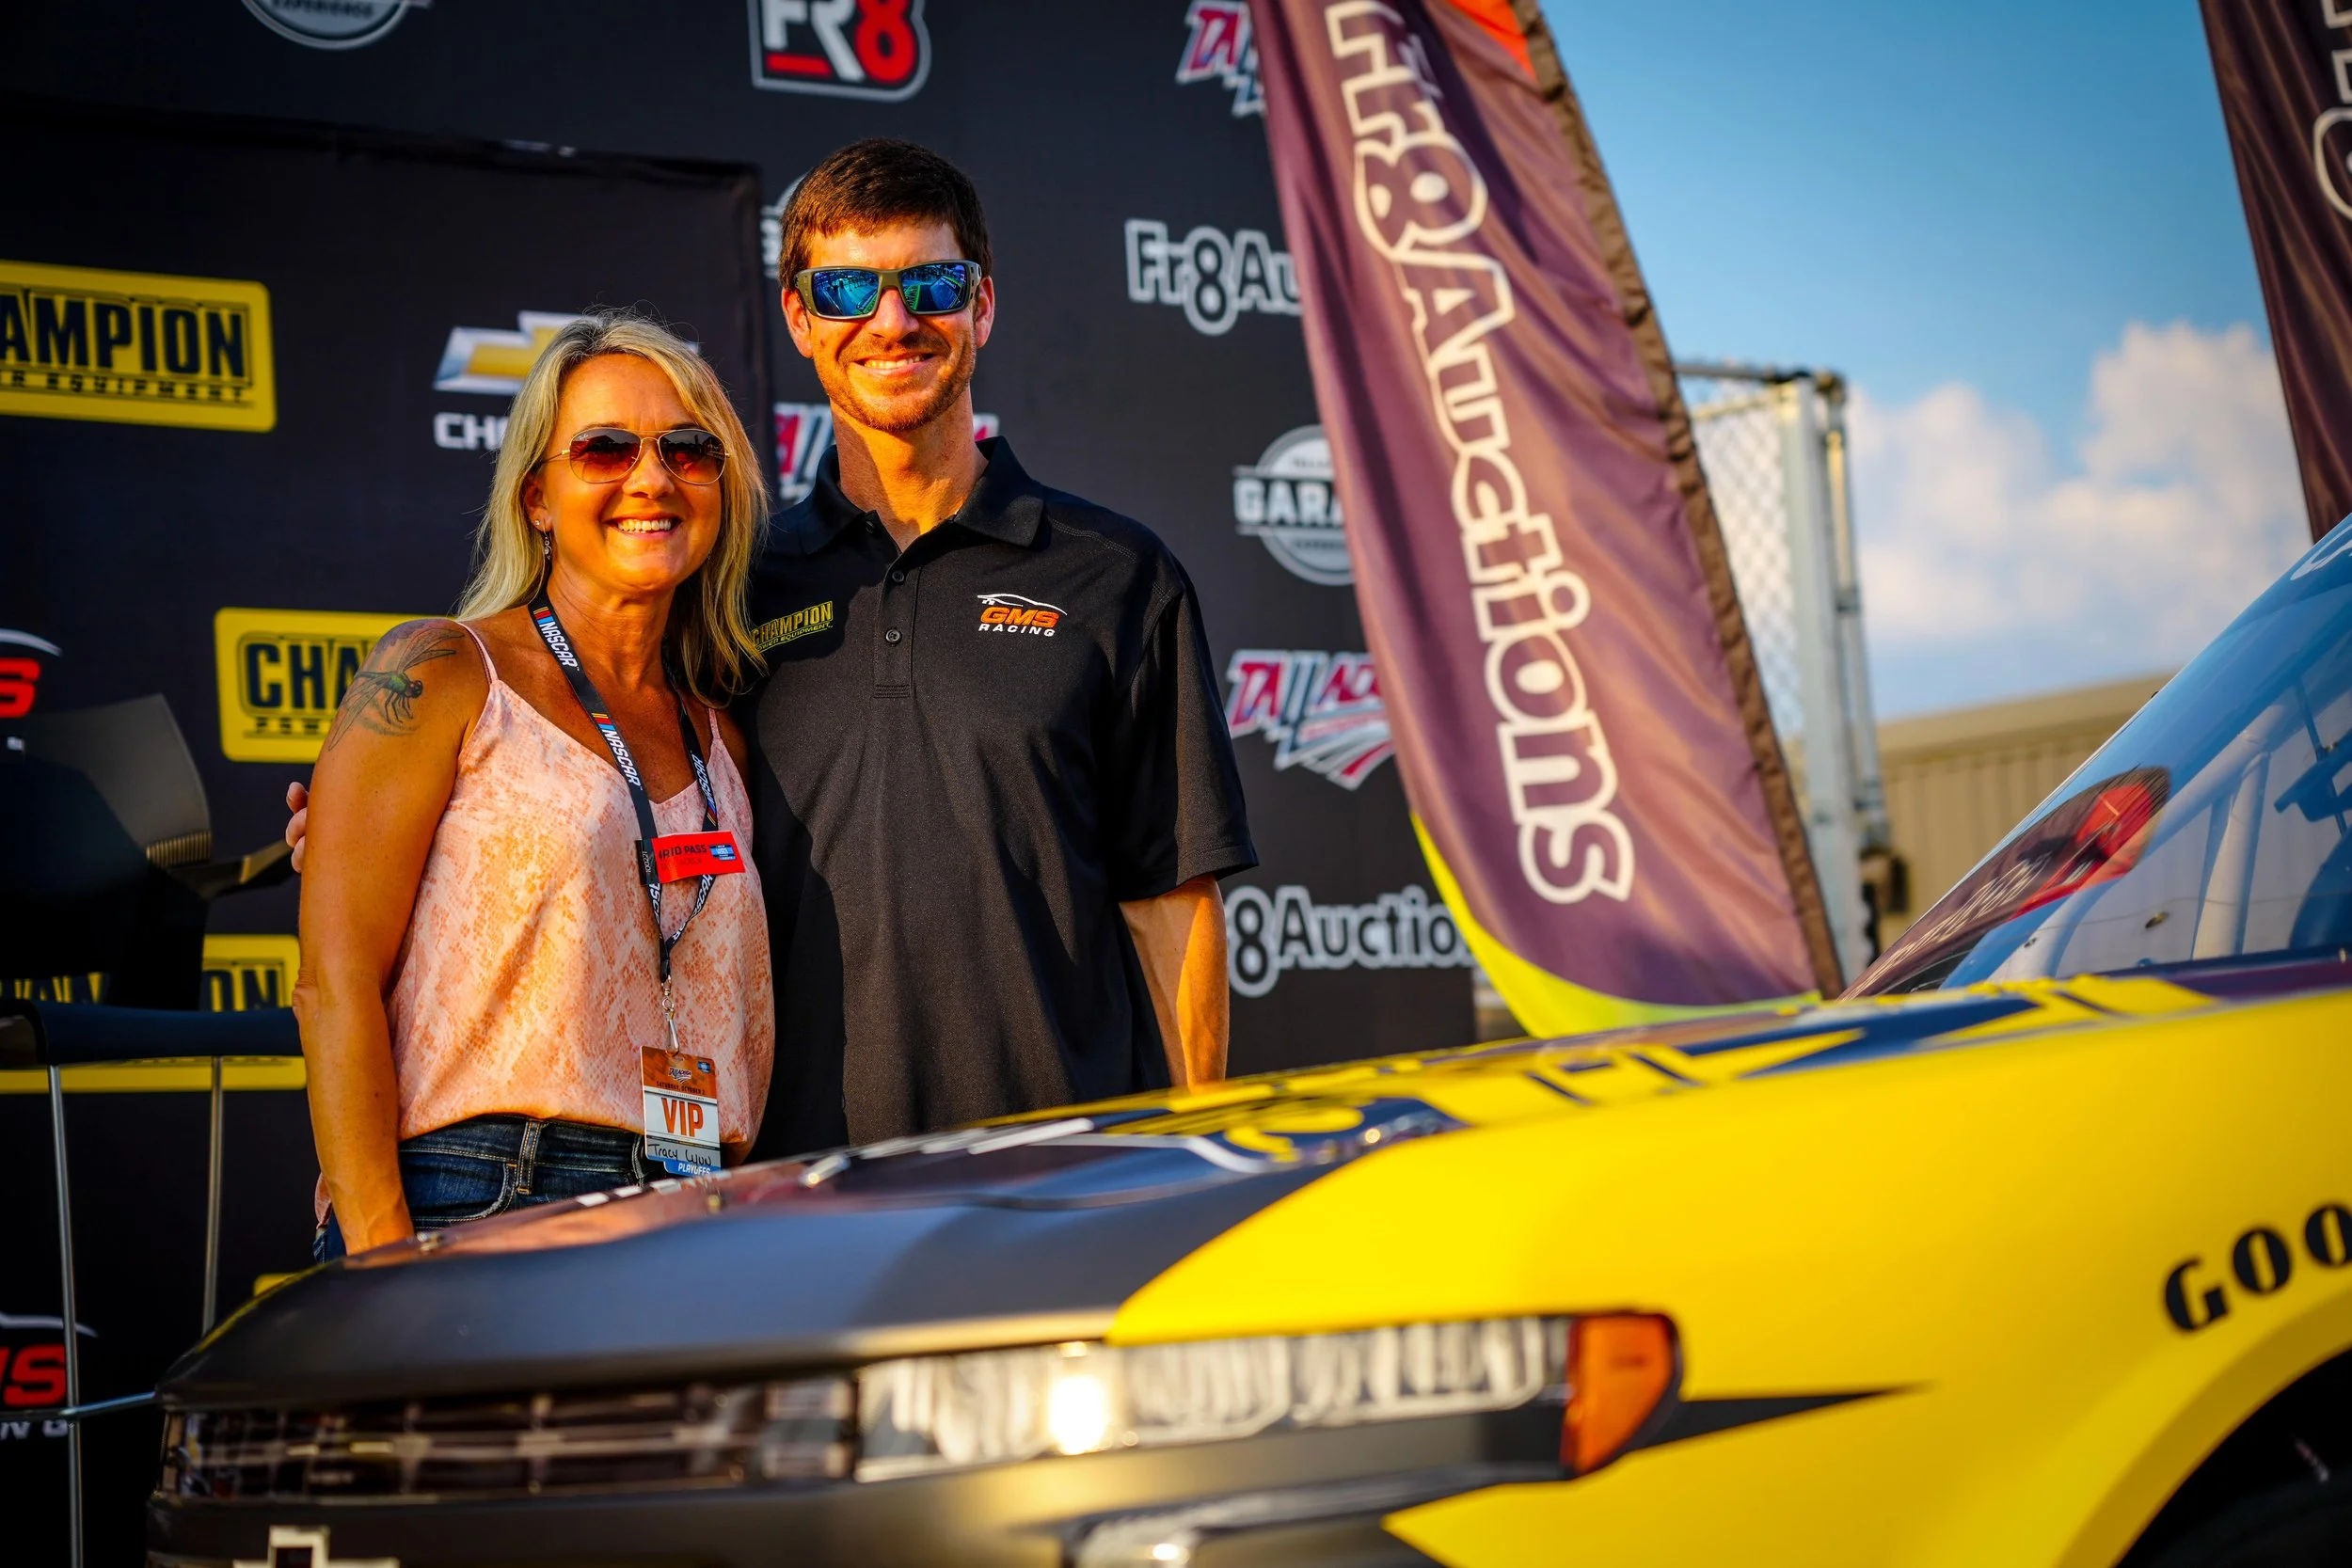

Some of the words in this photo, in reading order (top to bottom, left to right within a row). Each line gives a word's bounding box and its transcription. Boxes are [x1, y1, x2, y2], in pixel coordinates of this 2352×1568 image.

[762, 0, 915, 83] FR8
[434, 411, 508, 450] CH
[753, 602, 832, 646] CHAMPION
[780, 621, 830, 641] EQUIPMENT
[978, 623, 1056, 637] RACING
[980, 606, 1059, 628] GMS
[539, 622, 578, 669] NASCAR
[601, 729, 644, 787] NASCAR
[684, 844, 707, 854] PASS
[1225, 884, 1474, 998] 8Auctio
[681, 1085, 702, 1095] OCTOBER
[661, 1097, 704, 1137] VIP
[647, 1143, 678, 1161] Tracy
[677, 1162, 711, 1176] PLAYOFFS
[2165, 1203, 2352, 1334] GOO
